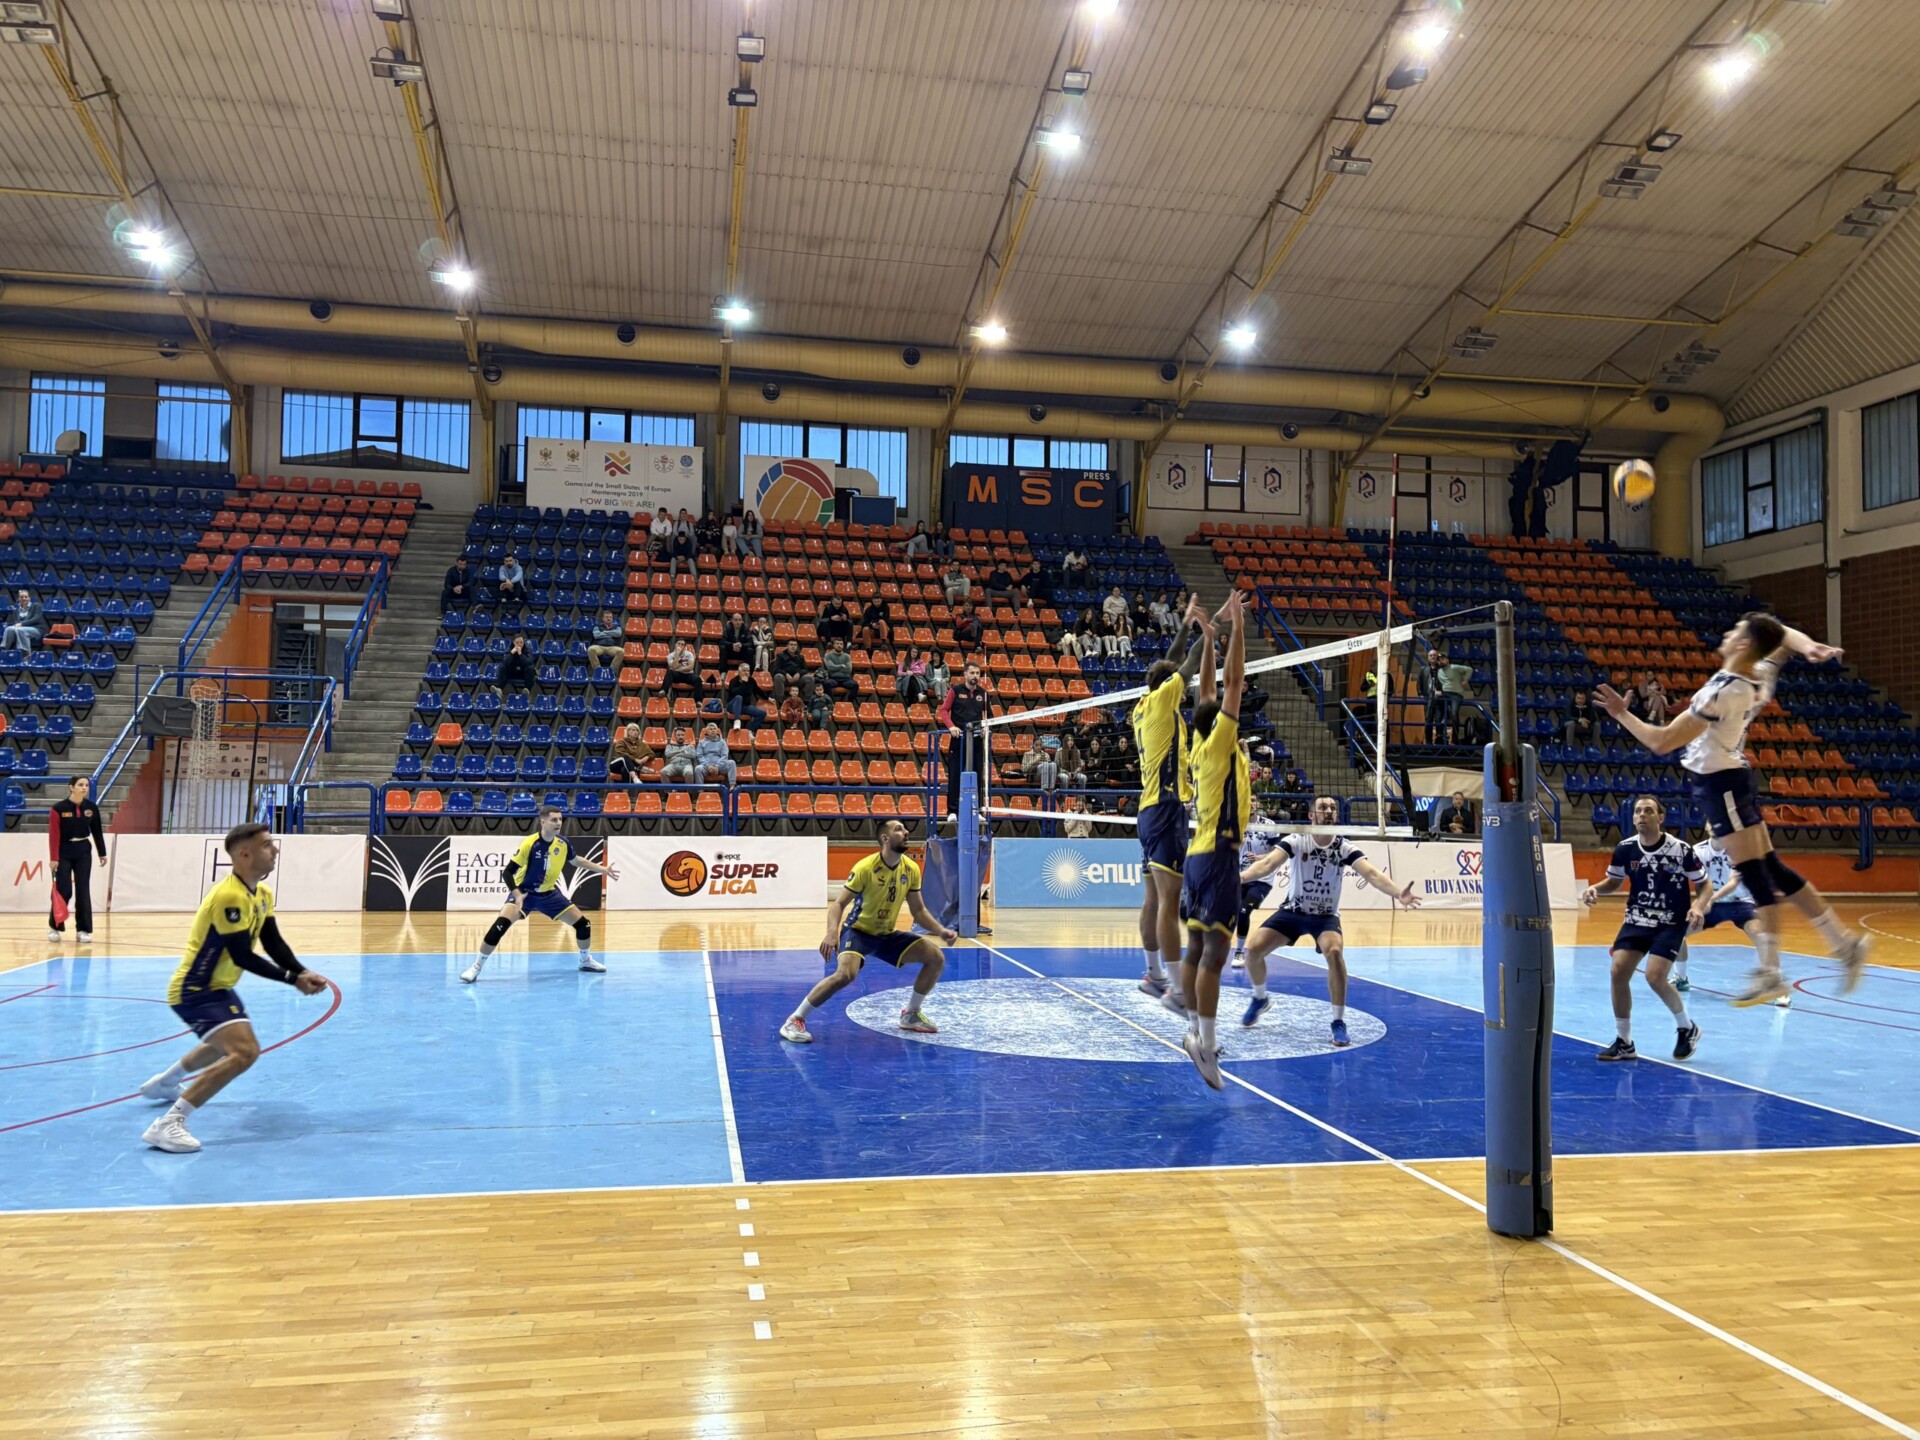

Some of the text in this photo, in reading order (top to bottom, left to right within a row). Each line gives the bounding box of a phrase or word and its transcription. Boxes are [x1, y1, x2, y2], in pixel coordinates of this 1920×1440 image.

[1083, 471, 1111, 481] PRESS
[591, 489, 627, 497] Montenegro
[605, 482, 622, 490] Small
[580, 497, 655, 509] HOW BIG WE ARE!
[725, 852, 741, 861] epcg
[710, 863, 779, 880] SUPER
[1313, 865, 1324, 880] 12
[1716, 868, 1722, 879] 7
[708, 879, 757, 896] LIGA
[1303, 880, 1330, 895] CM
[1425, 879, 1483, 894] BUDVANSK
[1647, 873, 1655, 890] 5
[1637, 891, 1667, 909] CM
